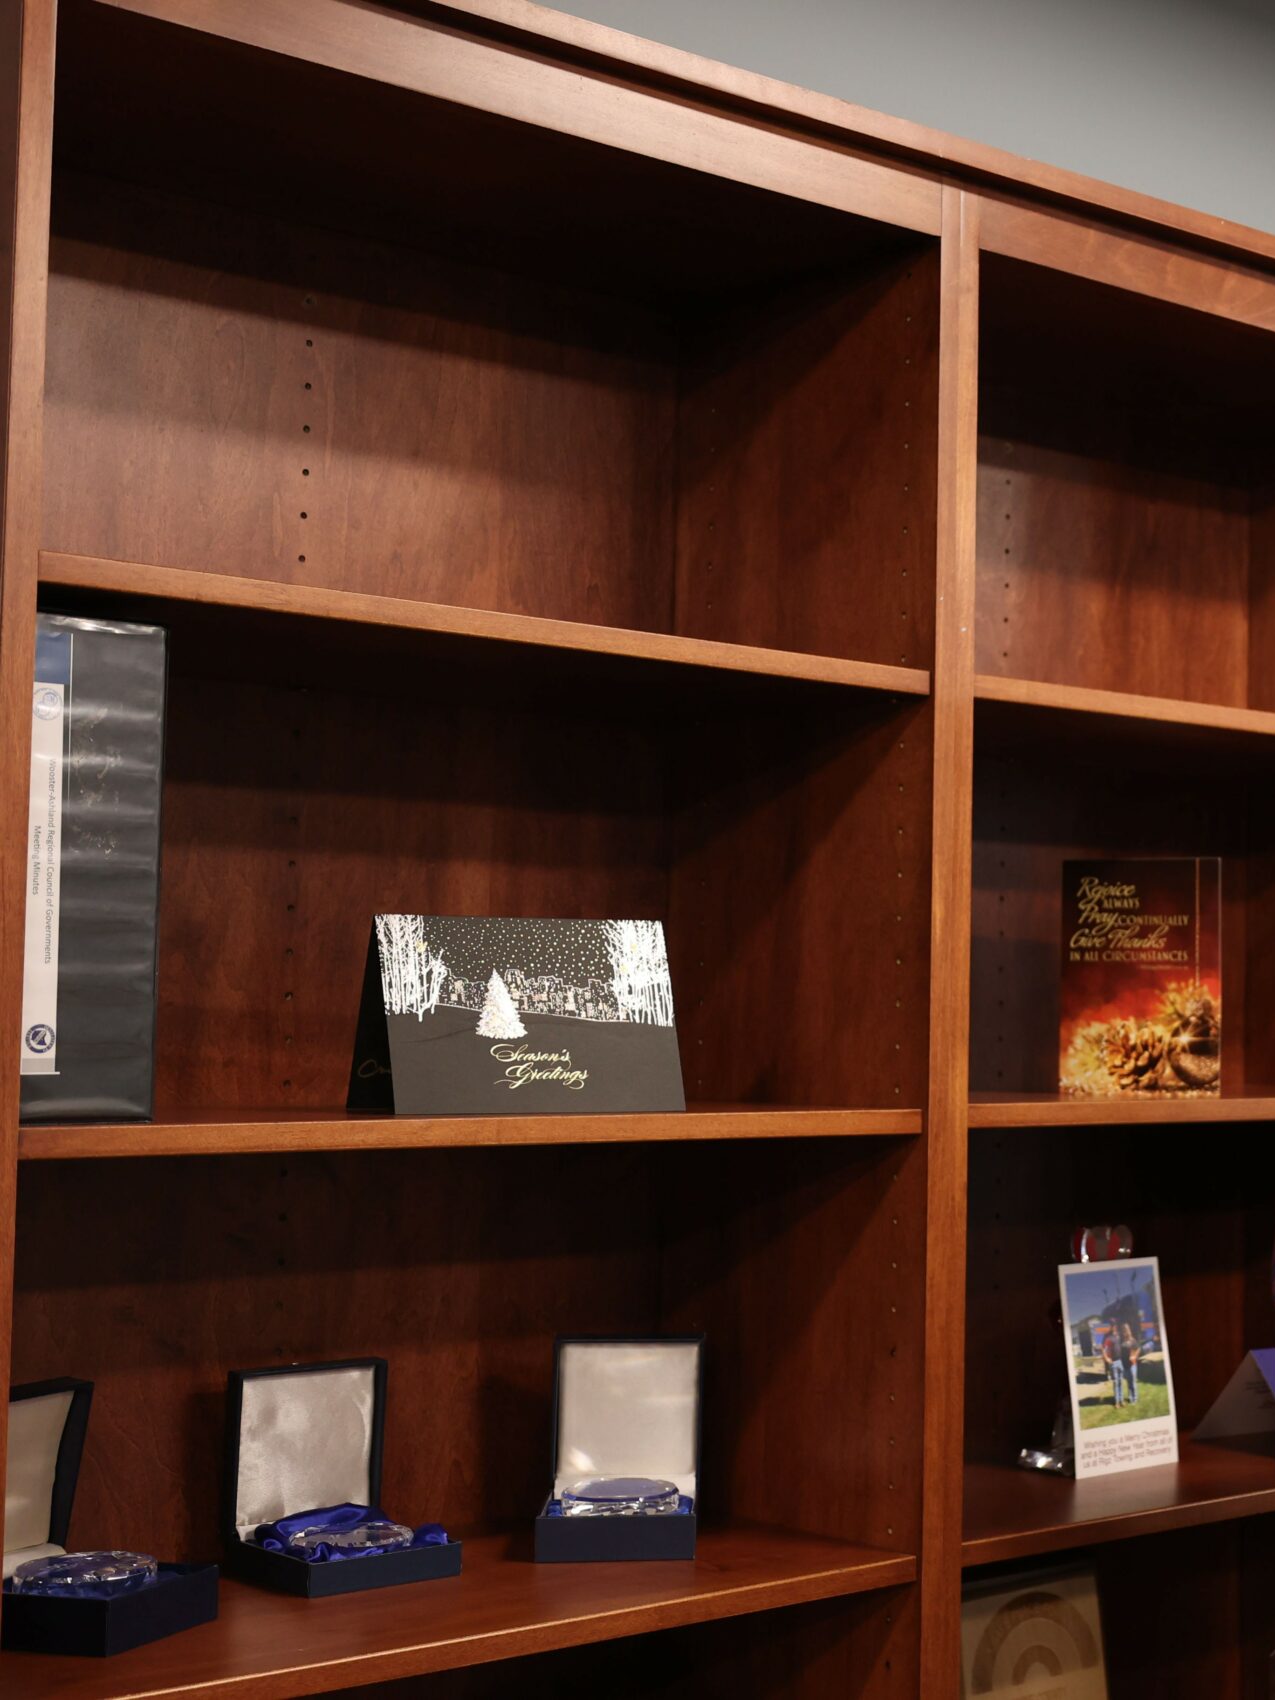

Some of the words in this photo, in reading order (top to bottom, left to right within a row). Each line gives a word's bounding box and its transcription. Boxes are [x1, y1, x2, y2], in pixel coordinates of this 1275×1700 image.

[48, 759, 56, 828] Wooster-Ashland
[32, 825, 41, 860] Meeting
[46, 829, 56, 865] Regional
[32, 861, 40, 896] Minutes
[46, 866, 55, 896] Council
[1076, 877, 1136, 909] Rejoice
[46, 898, 54, 907] of
[1102, 897, 1140, 909] ALWAYS
[1118, 914, 1189, 926] CONTINUALLY
[44, 909, 53, 965] Governments
[1070, 928, 1106, 948] Give
[1107, 925, 1170, 949] Thanks
[1069, 950, 1081, 961] IN
[1084, 950, 1099, 961] ALL
[1102, 950, 1188, 961] CIRCUMSTANCES
[490, 1043, 572, 1071] Season's
[493, 1061, 589, 1090] Greetings
